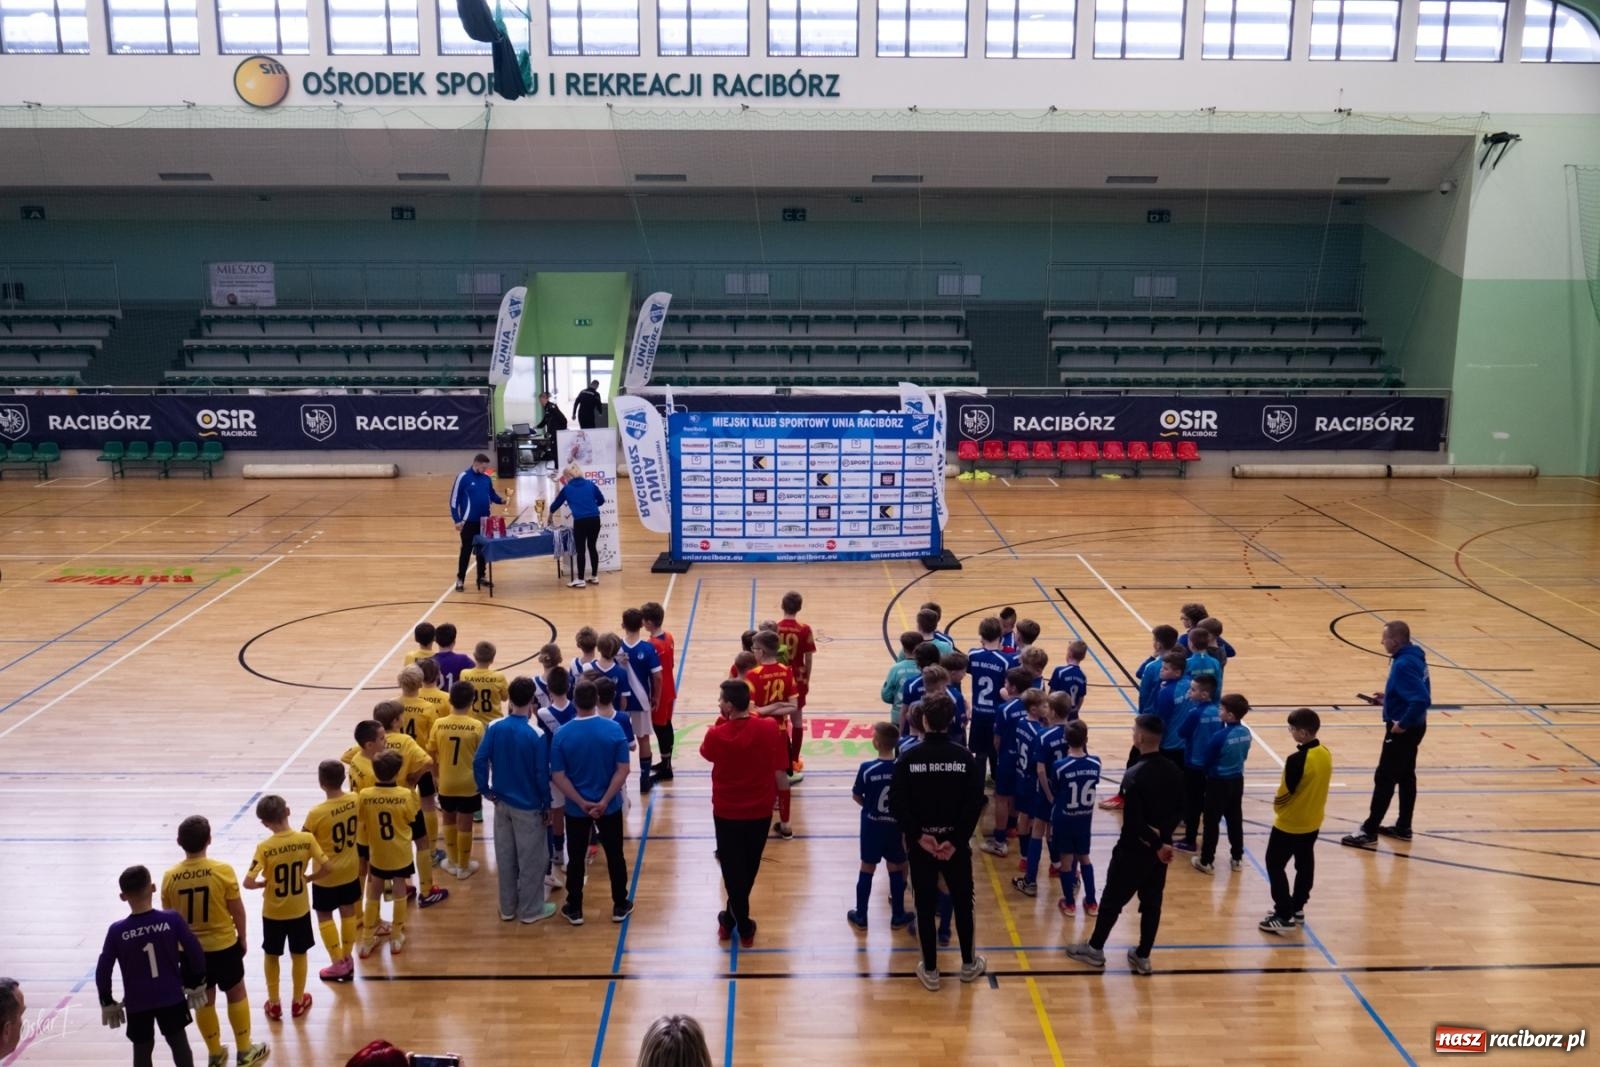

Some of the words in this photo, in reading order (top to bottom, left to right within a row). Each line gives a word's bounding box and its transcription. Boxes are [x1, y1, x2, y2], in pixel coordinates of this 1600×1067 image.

[303, 66, 427, 96] OŚRODEK
[436, 71, 539, 96] SPORU
[549, 72, 555, 97] I
[565, 72, 702, 97] REKREACJI
[713, 69, 840, 98] RACIBÓRZ
[216, 264, 267, 275] MIESZKO
[498, 330, 511, 364] UNIA
[636, 334, 650, 368] UNIA
[48, 410, 152, 431] RACIBÓRZ
[356, 411, 459, 431] RACIBÓRZ
[712, 416, 750, 428] MIEJSKI
[752, 416, 777, 428] KLUB
[779, 417, 830, 429] SPORTOWY
[832, 417, 855, 429] UNIA
[857, 415, 904, 429] RACIBÓRZ
[1013, 411, 1116, 432] RACIBÓRZ
[1315, 412, 1416, 433] RACIBÓRZ
[977, 675, 994, 707] 2
[437, 723, 476, 732] PIWOWAR
[449, 736, 461, 766] 7
[909, 763, 927, 773] UNIA
[929, 761, 967, 773] RACIBÓRZ
[1066, 779, 1097, 809] 16
[332, 815, 357, 854] 99
[378, 811, 395, 841] 8
[171, 868, 213, 882] WÓJCIK
[274, 860, 304, 898] 90
[178, 885, 209, 925] 77
[121, 921, 171, 941] GRZYWA
[142, 942, 159, 979] 1
